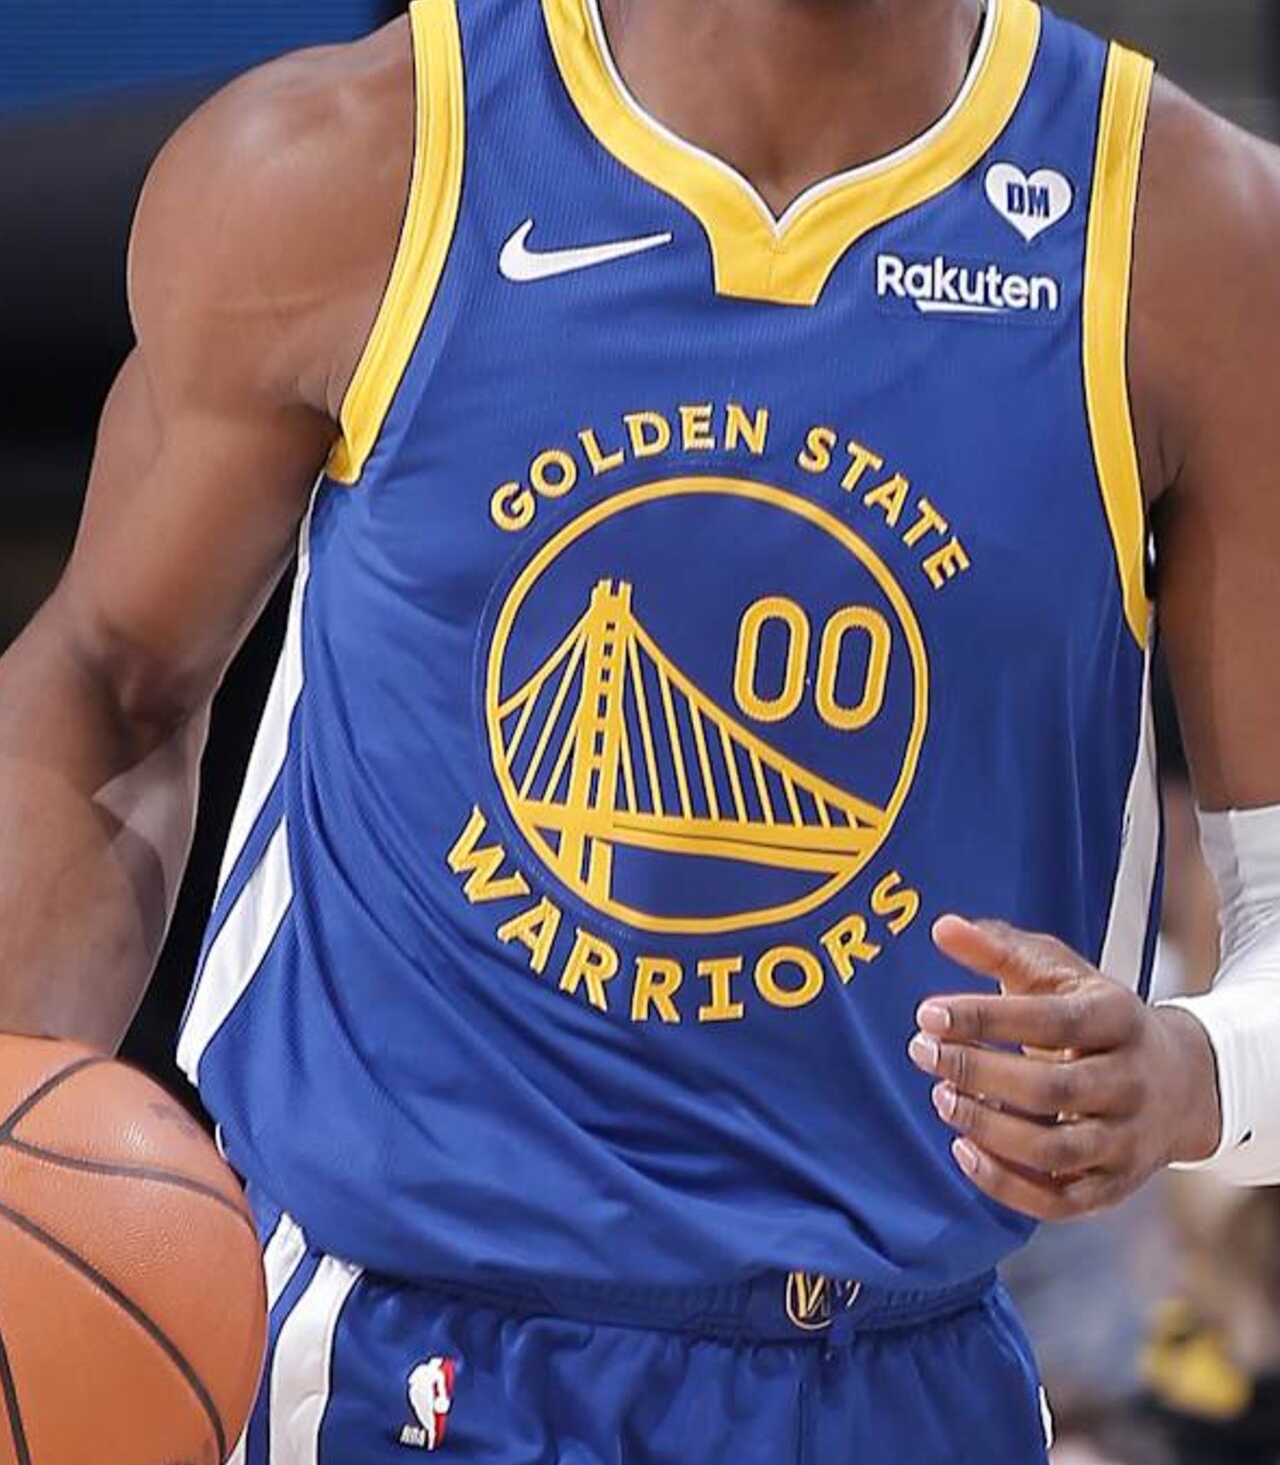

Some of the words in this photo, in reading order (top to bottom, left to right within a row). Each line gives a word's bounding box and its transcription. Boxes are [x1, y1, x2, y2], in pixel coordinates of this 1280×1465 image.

[1005, 181, 1051, 219] DM
[876, 253, 1059, 312] Rakuten
[489, 401, 770, 533] GOLDEN
[796, 426, 971, 590] STATE
[732, 595, 892, 731] 00
[446, 804, 921, 1023] WARRIORS
